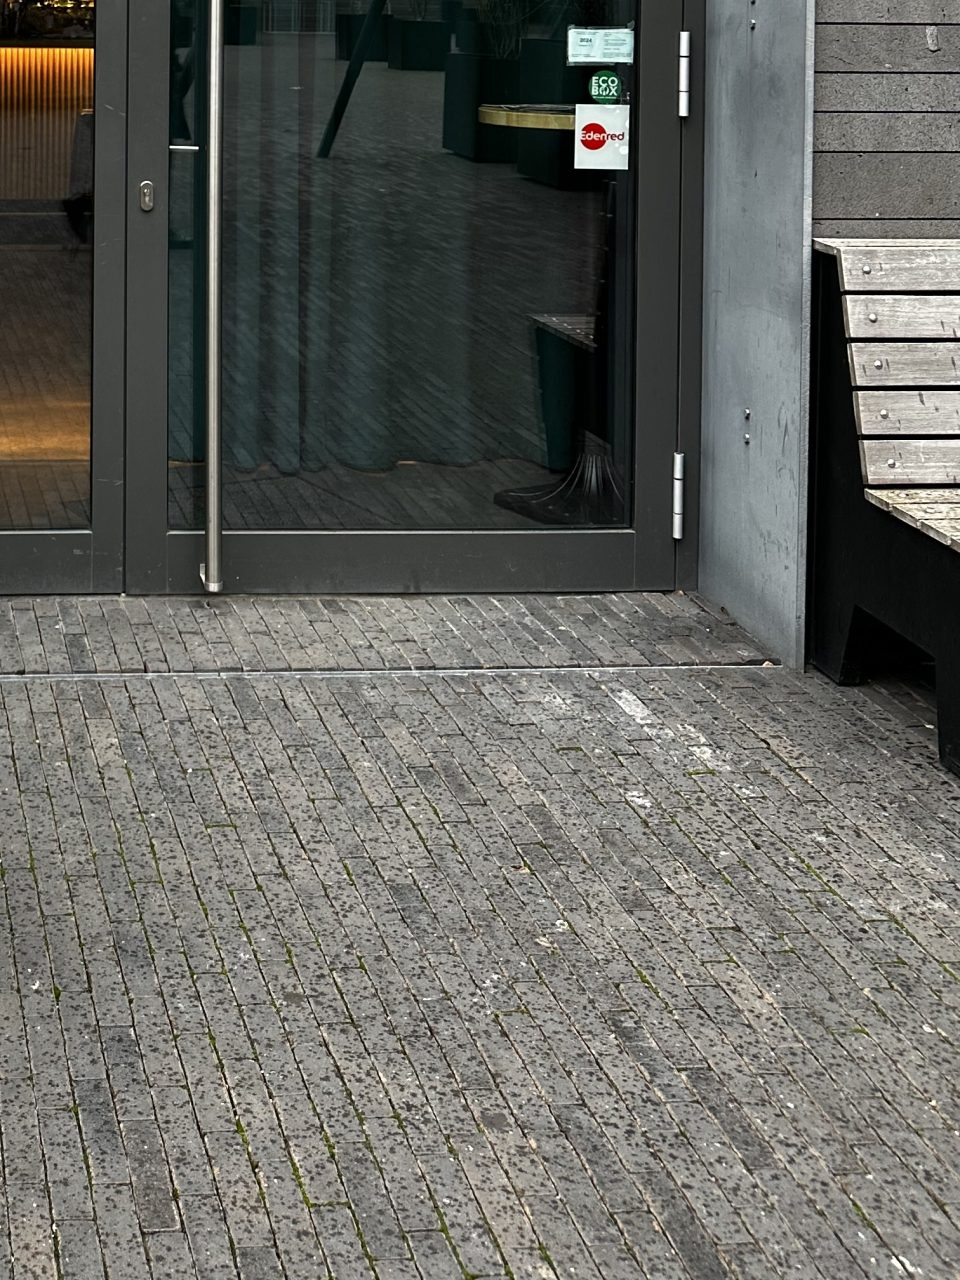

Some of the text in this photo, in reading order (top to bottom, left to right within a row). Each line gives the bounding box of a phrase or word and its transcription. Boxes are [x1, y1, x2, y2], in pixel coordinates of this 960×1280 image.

[591, 76, 618, 87] ECO
[591, 86, 618, 96] BOX
[580, 130, 625, 141] Edenred
